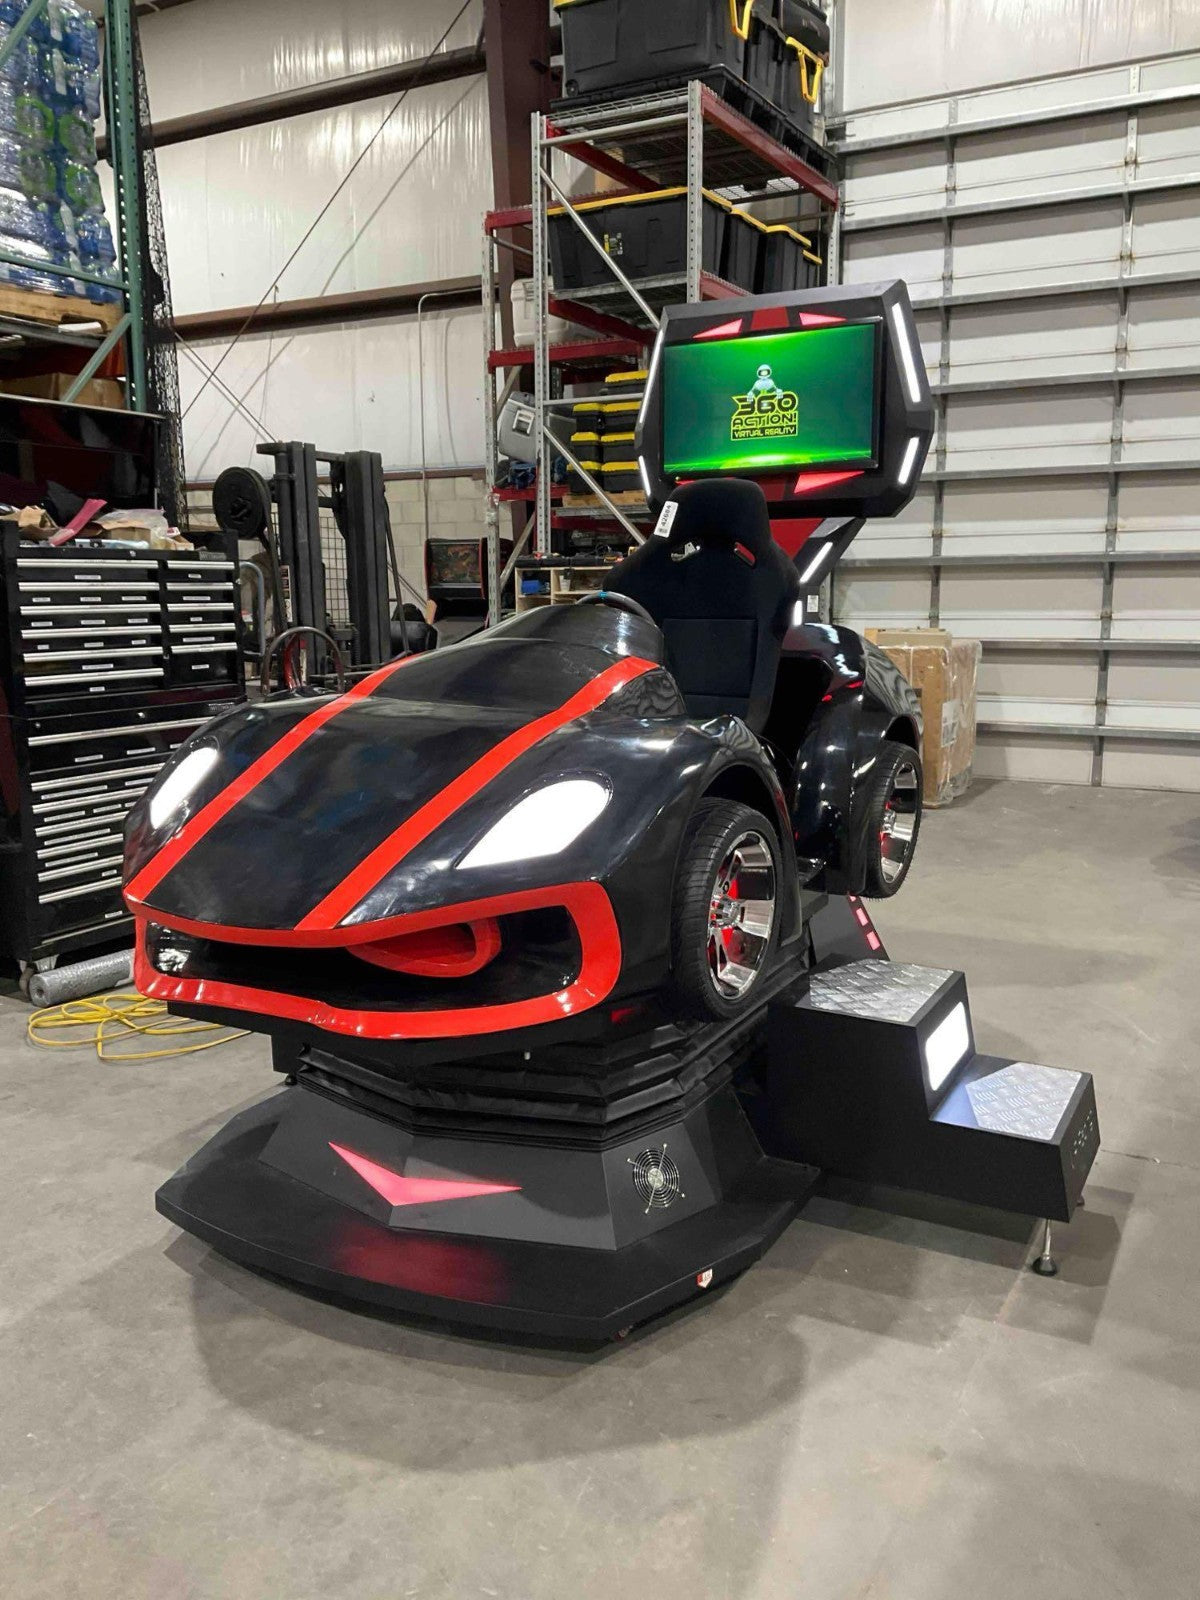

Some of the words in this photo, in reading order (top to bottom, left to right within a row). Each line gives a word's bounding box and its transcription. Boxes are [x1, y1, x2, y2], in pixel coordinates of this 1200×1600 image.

[732, 391, 798, 417] 360
[732, 413, 797, 428] ACTION!
[733, 429, 763, 438] VIRTUAL
[764, 427, 795, 436] REALITY
